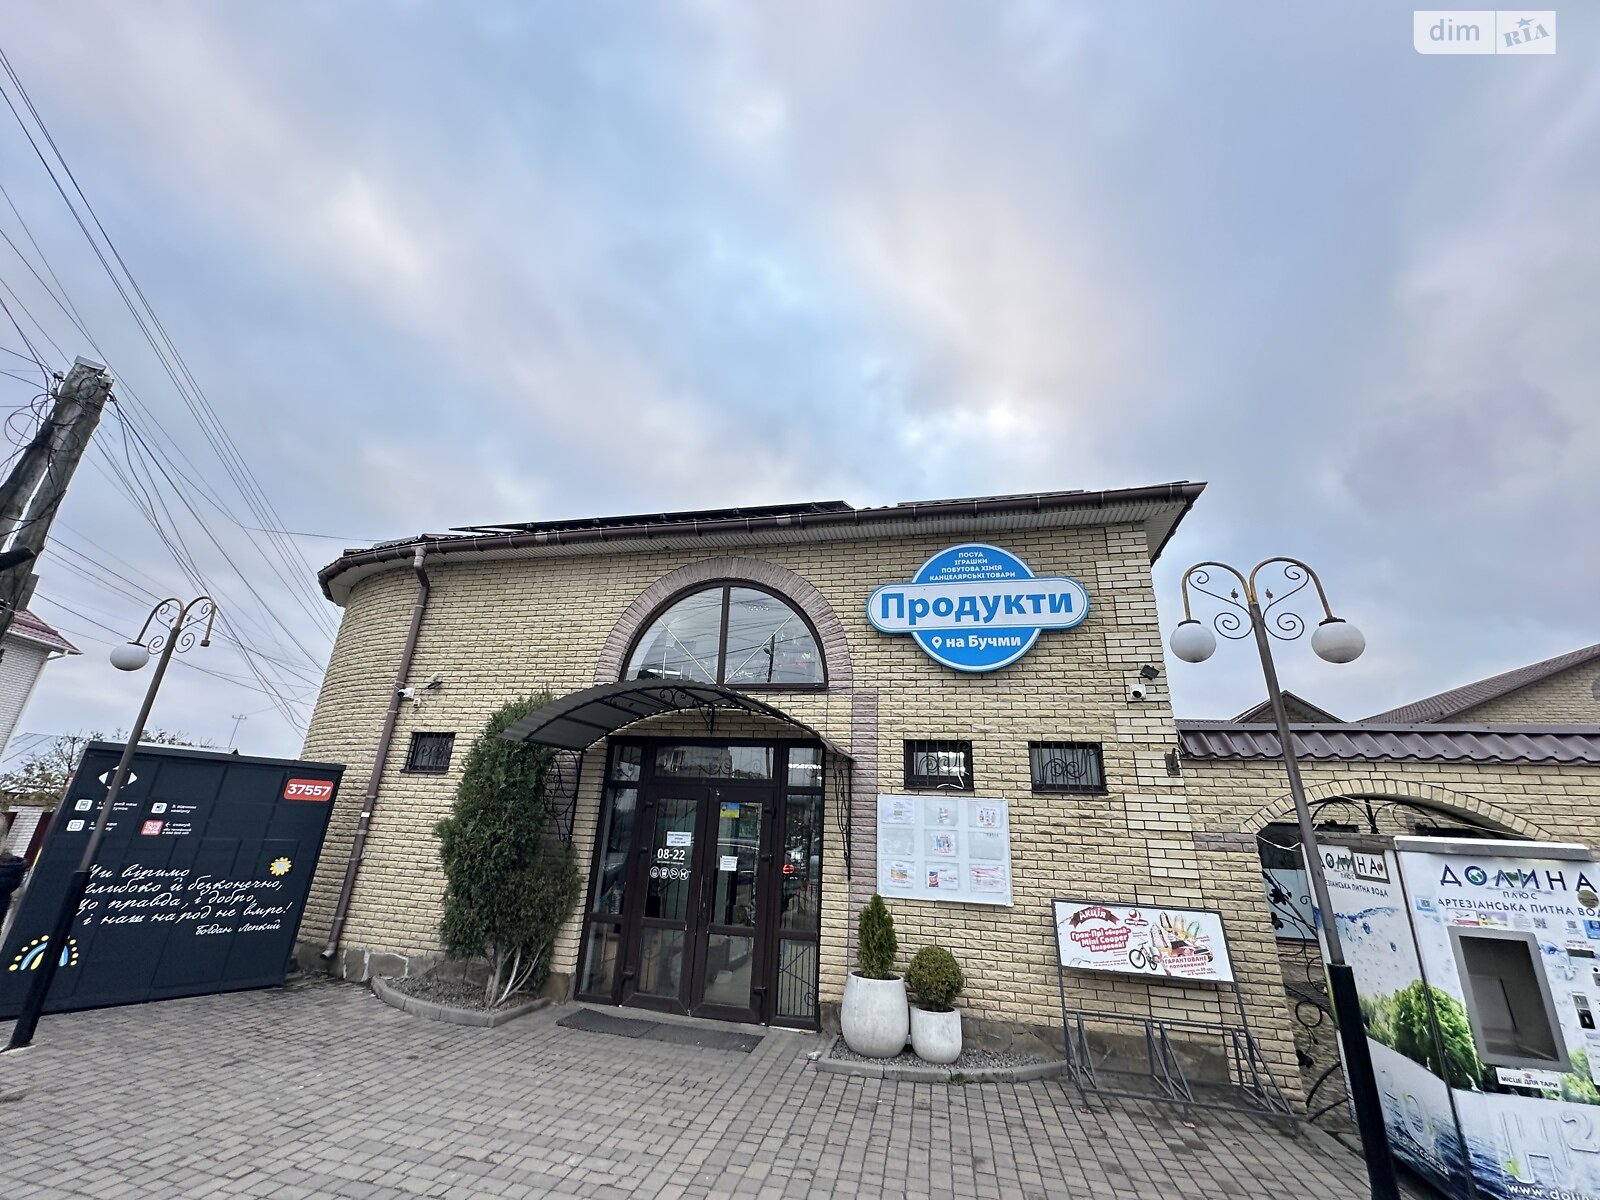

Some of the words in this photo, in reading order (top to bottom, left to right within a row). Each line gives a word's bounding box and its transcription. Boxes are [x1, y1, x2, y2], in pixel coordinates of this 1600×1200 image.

[954, 558, 988, 566] ІГРАШКИ
[929, 573, 985, 582] КАНЦЕЛЯРСЬКІ
[986, 571, 1016, 579] ТОВАРИ
[941, 566, 980, 574] ПОБУТОВА
[881, 592, 1074, 626] Продукти
[945, 637, 966, 648] на
[968, 634, 1022, 651] Бучми
[287, 783, 332, 797] 37557
[657, 848, 686, 861] 08-22
[121, 863, 190, 880] віримо
[1439, 863, 1598, 893] ДОЛИНА
[84, 877, 161, 894] глибоко
[170, 878, 184, 892] й
[187, 875, 283, 896] безконечно,
[1371, 886, 1388, 897] ВОДА
[208, 888, 257, 906] добро,
[1503, 890, 1538, 900] ПЛЮС
[82, 913, 94, 926] і
[100, 913, 146, 925] наш
[215, 907, 236, 919] не
[243, 901, 294, 917] вмре!
[1438, 898, 1527, 912] АРТЕЗІАНСЬКА
[1530, 904, 1575, 916] ПИТНА
[194, 923, 233, 936] Богдан
[1099, 934, 1128, 944] Cooper
[1165, 955, 1208, 965] ГАРАНТОВАНЕ
[1500, 1075, 1522, 1084] МІСЦЕ
[1524, 1078, 1539, 1086] ДЛЯ
[1539, 1080, 1559, 1088] ТАРИ
